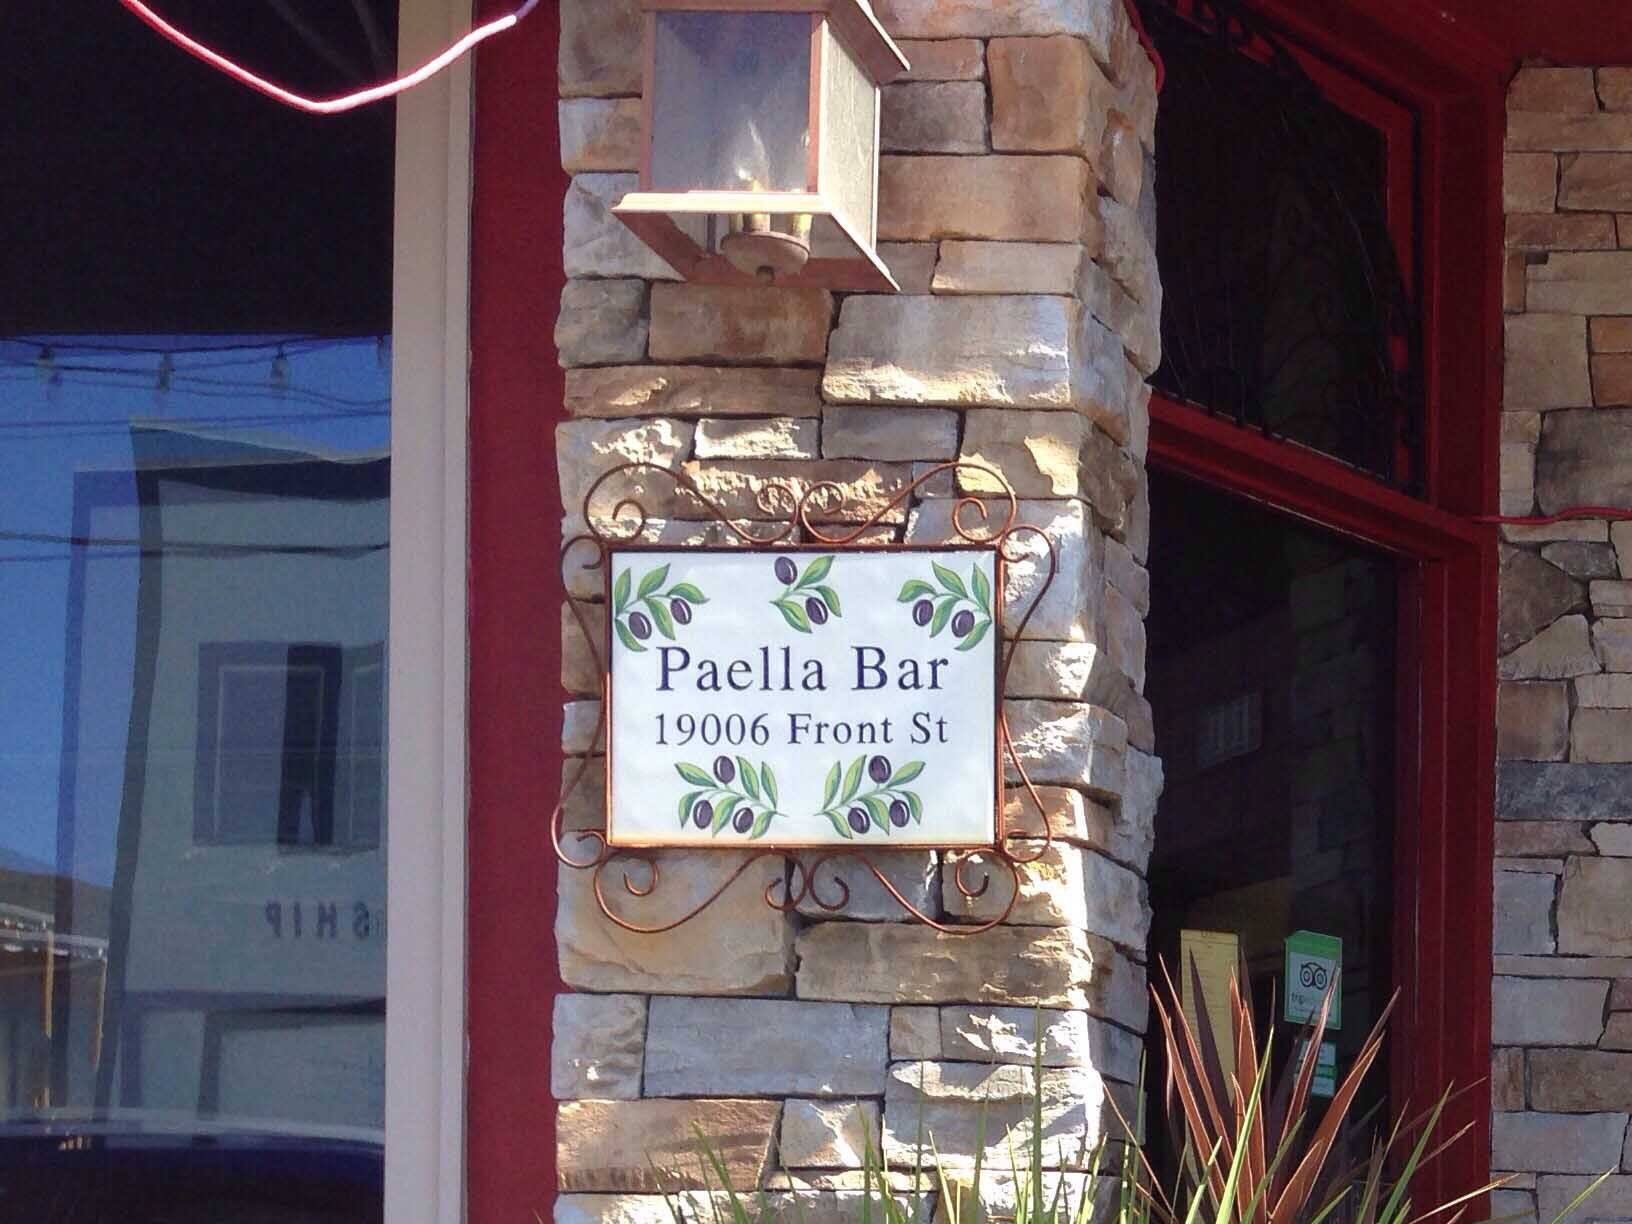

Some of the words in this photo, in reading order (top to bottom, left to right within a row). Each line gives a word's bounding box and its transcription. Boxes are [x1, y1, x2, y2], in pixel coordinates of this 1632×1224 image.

[655, 644, 827, 692] Paella
[850, 644, 950, 692] Bar
[655, 712, 770, 746] 19006
[786, 712, 894, 746] Front
[910, 711, 949, 746] St
